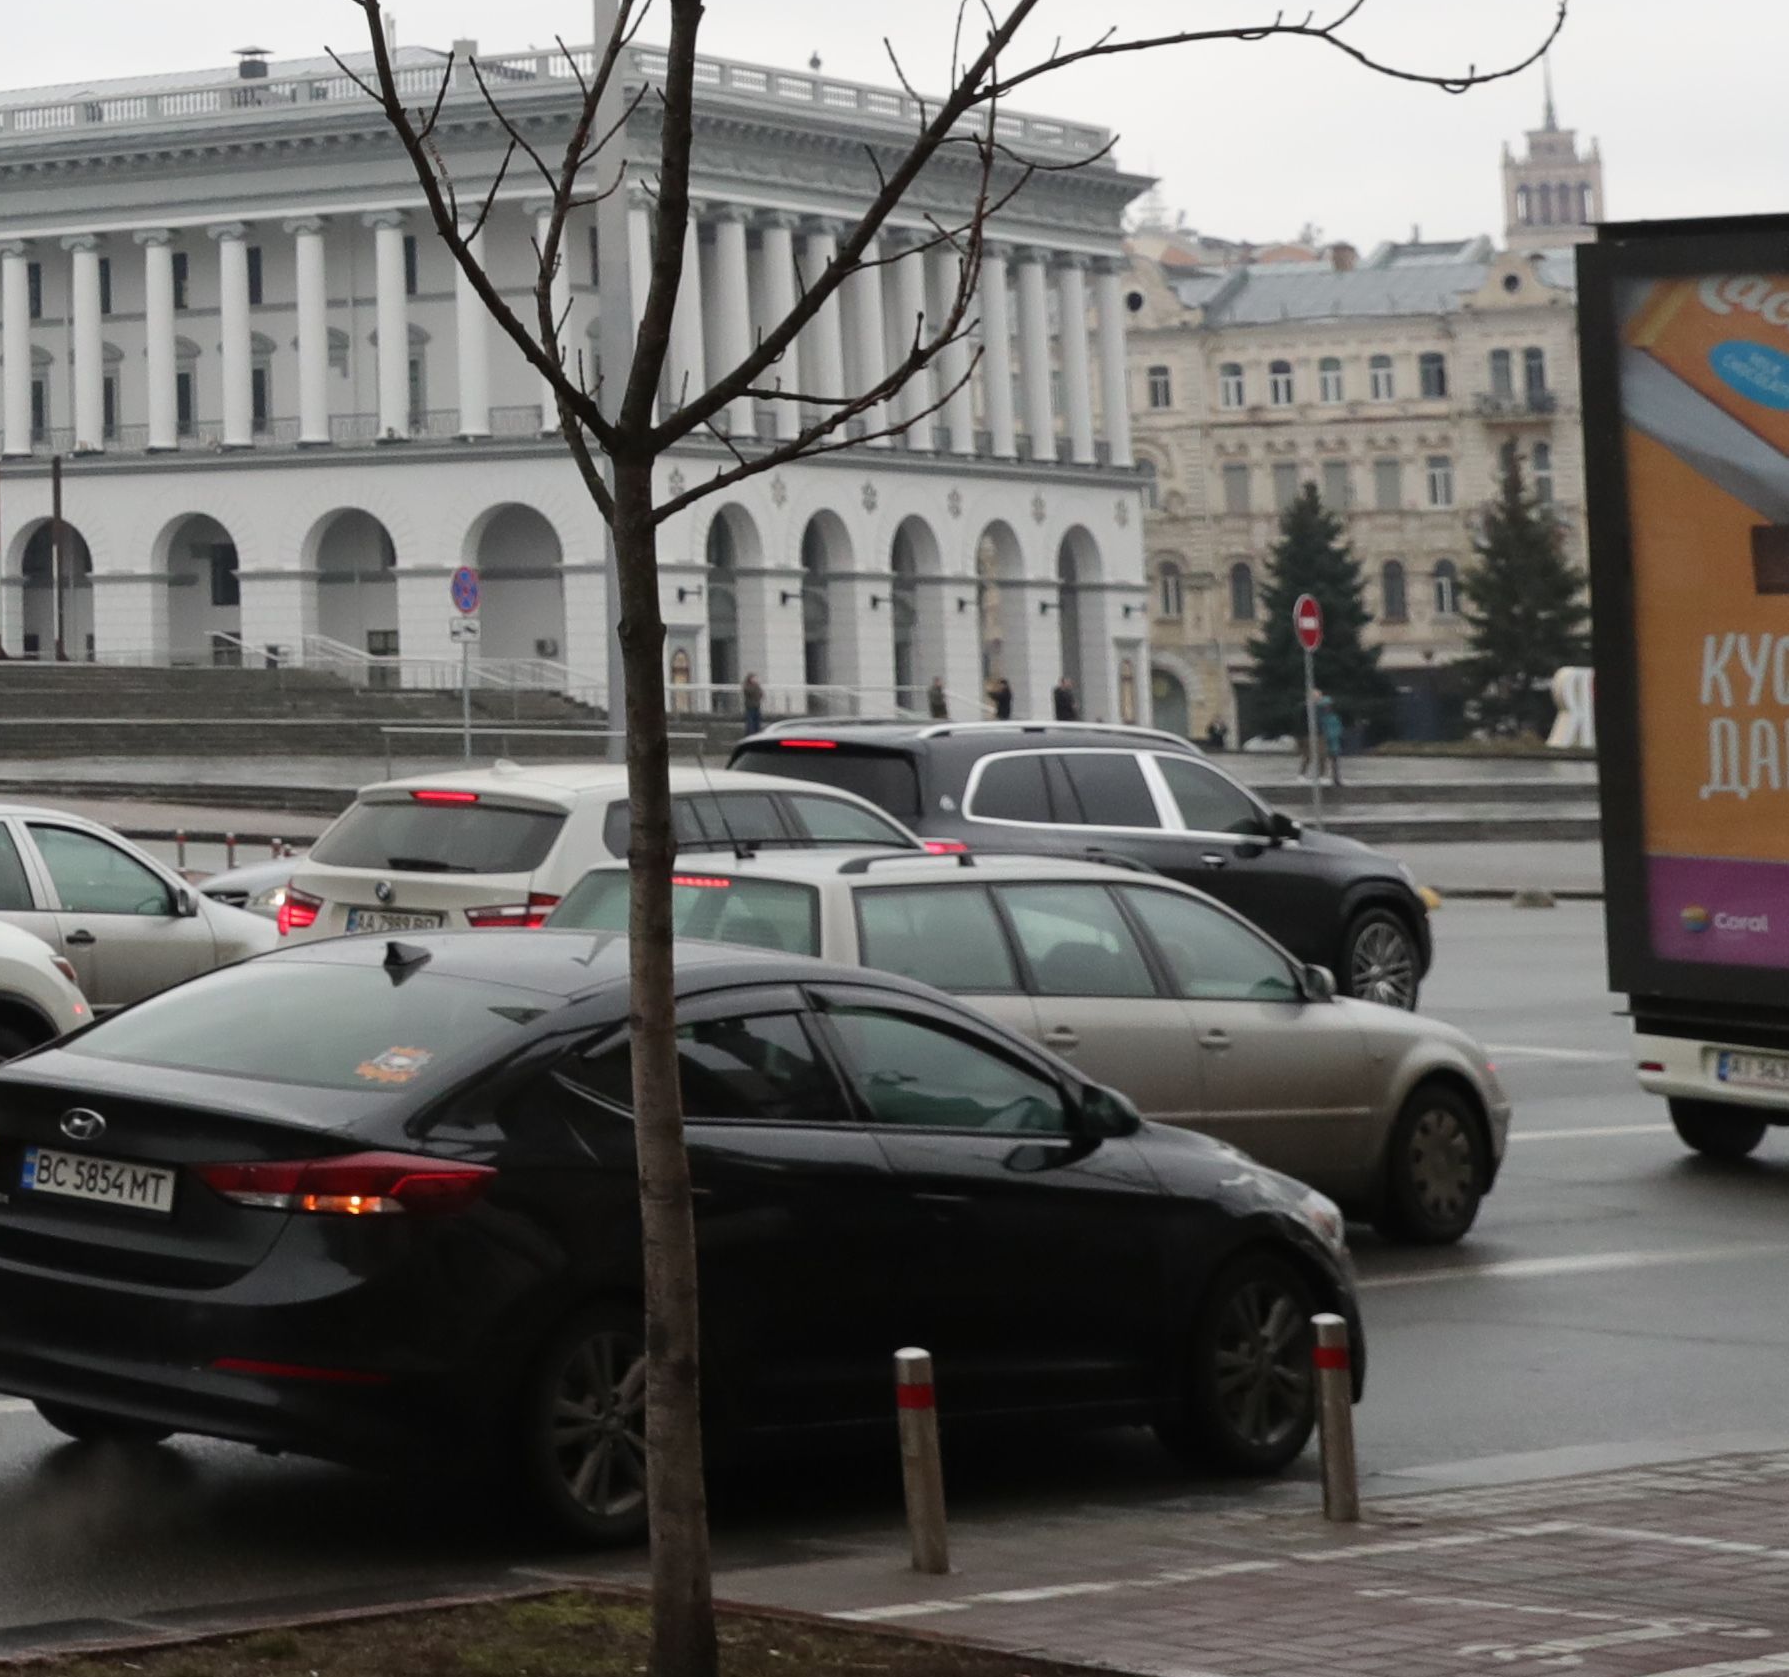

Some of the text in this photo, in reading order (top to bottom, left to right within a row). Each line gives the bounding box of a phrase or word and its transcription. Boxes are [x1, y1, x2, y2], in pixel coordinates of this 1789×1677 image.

[1698, 716, 1789, 801] ДА
[37, 1154, 167, 1205] BC 5854 MT
